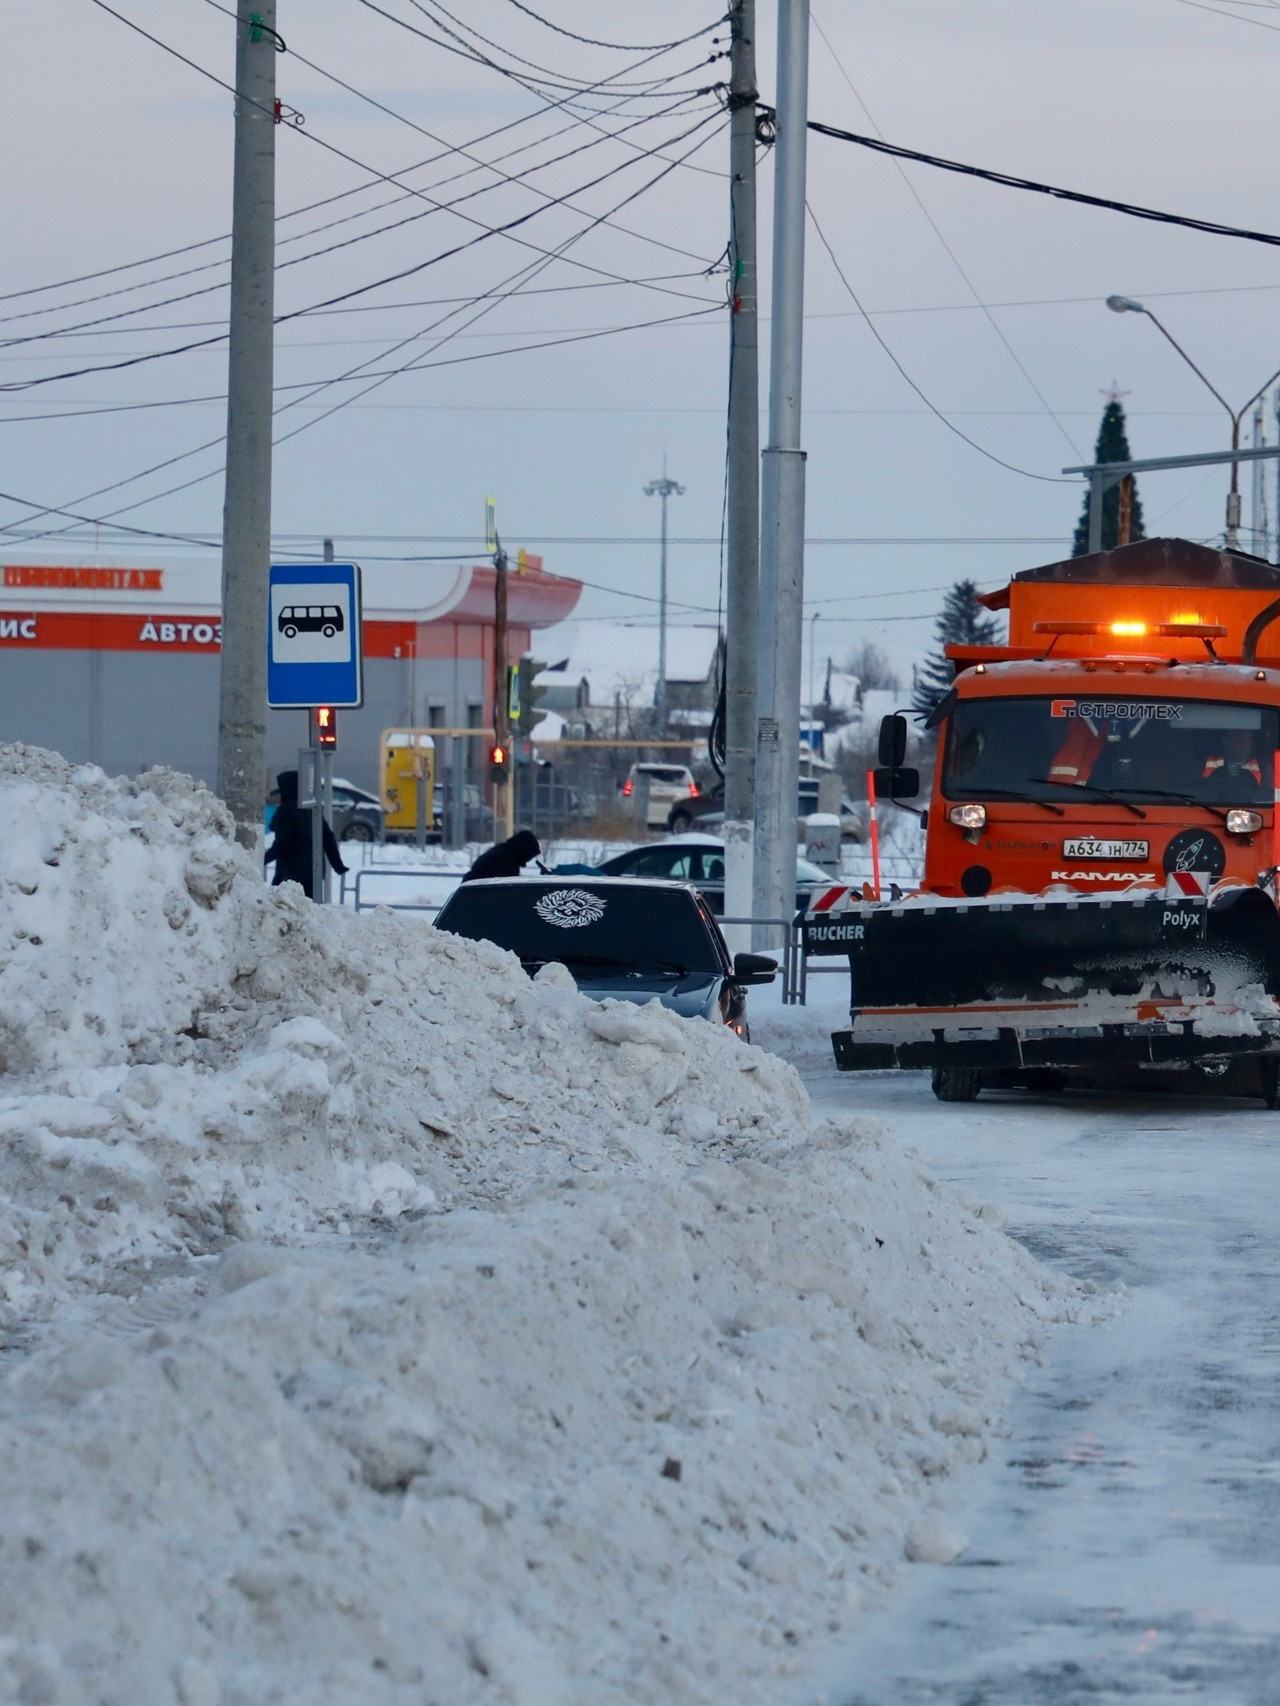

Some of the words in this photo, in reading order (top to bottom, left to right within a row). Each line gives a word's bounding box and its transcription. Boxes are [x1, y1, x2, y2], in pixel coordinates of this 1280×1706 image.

[1051, 871, 1156, 882] KAMAZ
[1162, 910, 1200, 929] Polyx
[808, 925, 864, 940] BUCHER
